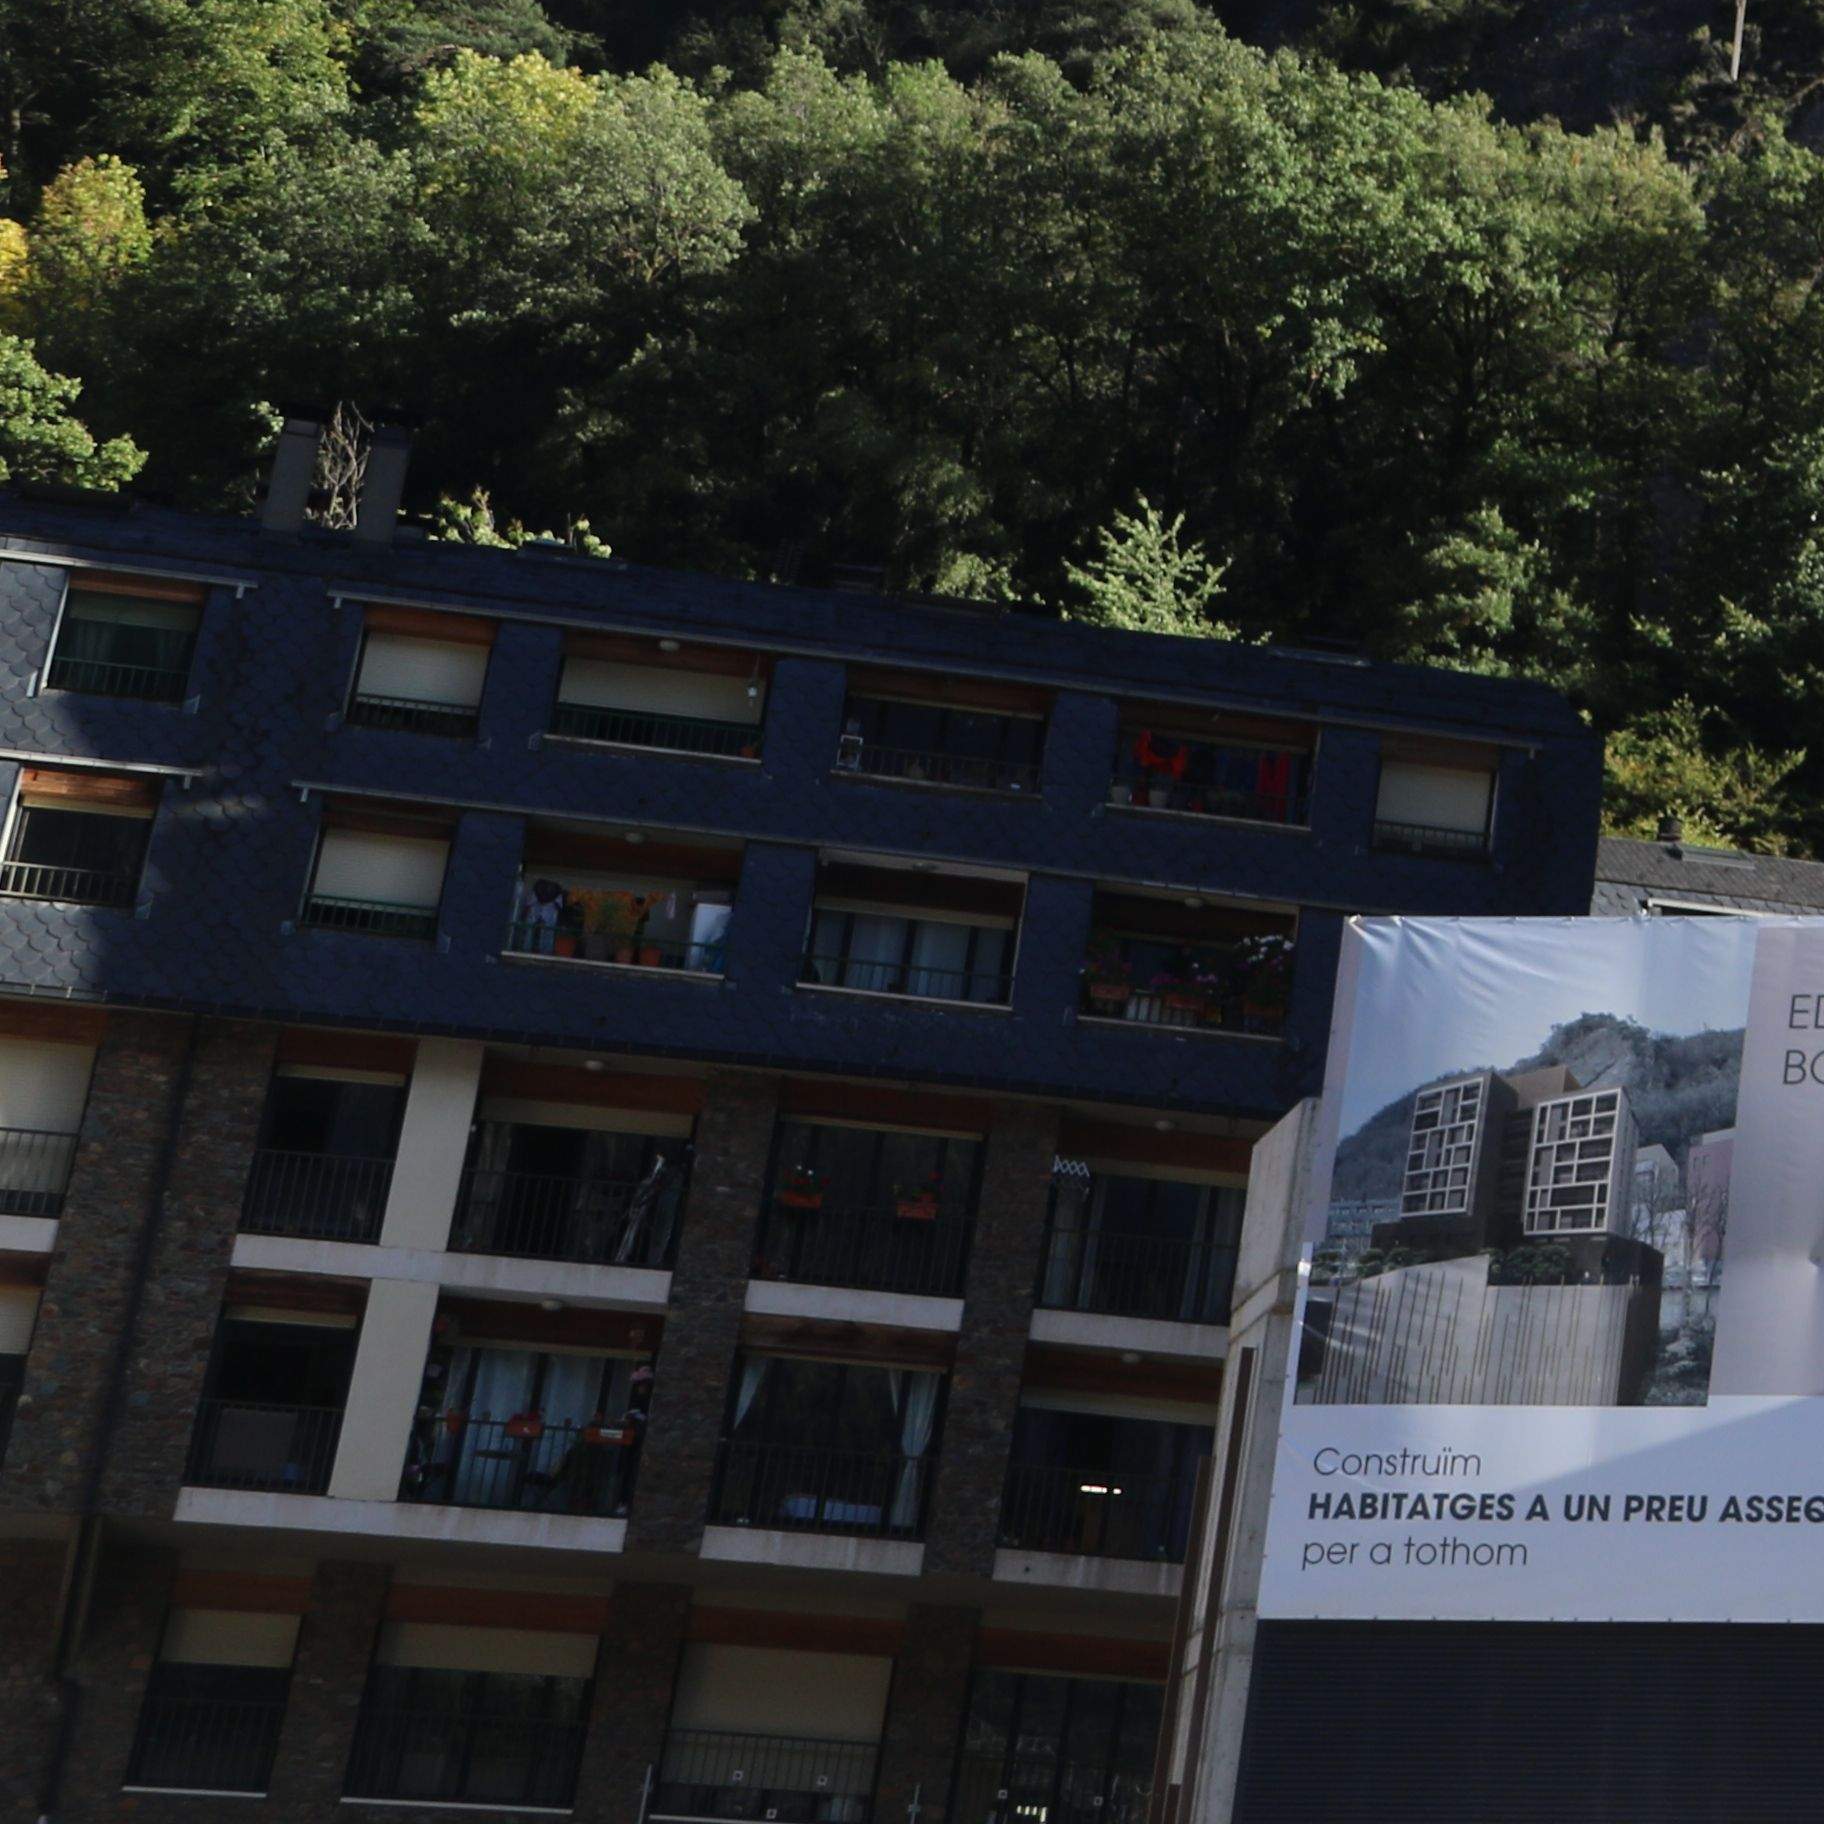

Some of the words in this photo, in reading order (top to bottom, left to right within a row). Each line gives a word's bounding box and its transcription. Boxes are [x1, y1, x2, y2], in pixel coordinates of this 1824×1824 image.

[1314, 1446, 1481, 1476] Construïm
[1308, 1493, 1516, 1521] HABITATGES
[1525, 1494, 1549, 1521] A
[1563, 1494, 1610, 1522] UN
[1624, 1495, 1708, 1522] PREU
[1301, 1541, 1358, 1570] per
[1369, 1542, 1391, 1565] a
[1404, 1536, 1527, 1565] tothom
